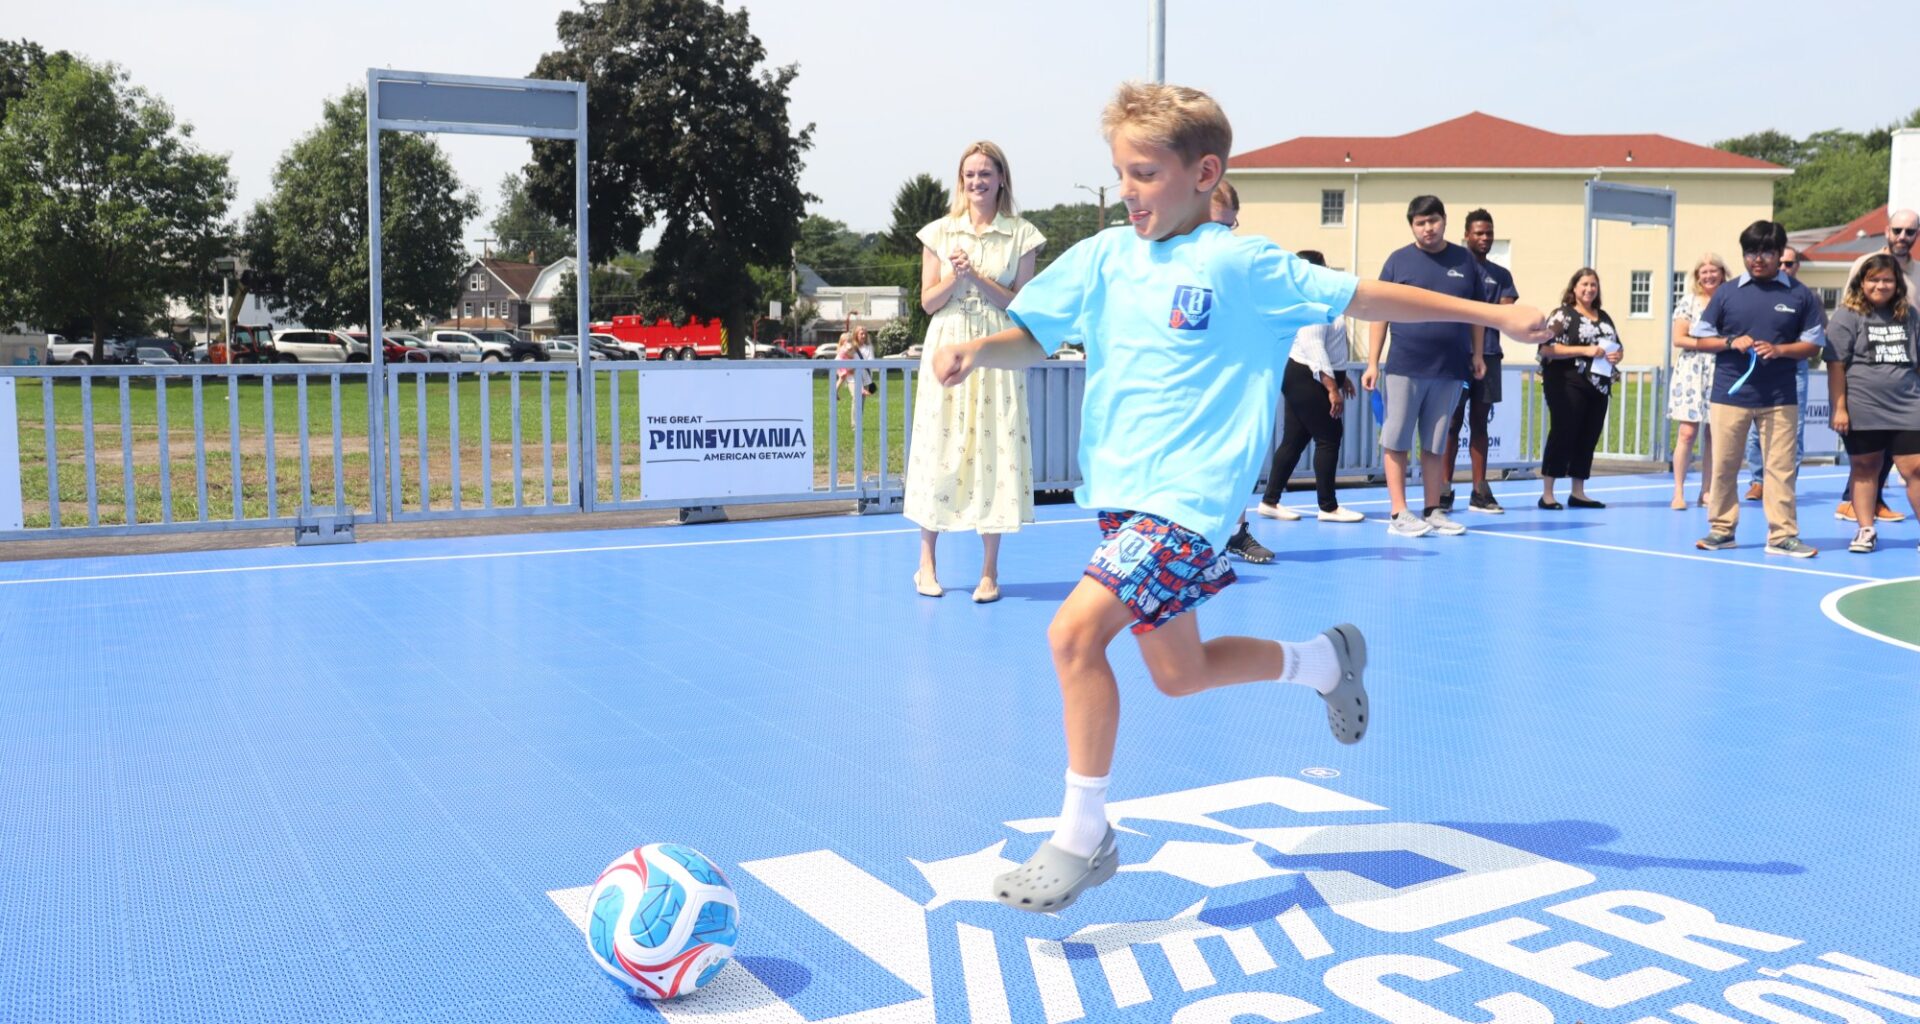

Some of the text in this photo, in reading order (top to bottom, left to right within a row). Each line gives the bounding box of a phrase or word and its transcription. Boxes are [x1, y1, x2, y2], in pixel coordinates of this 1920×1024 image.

[647, 415, 703, 424] THE GREAT
[649, 428, 807, 450] PENNSYLVANIA
[704, 451, 807, 461] AMERICAN GETAWAY
